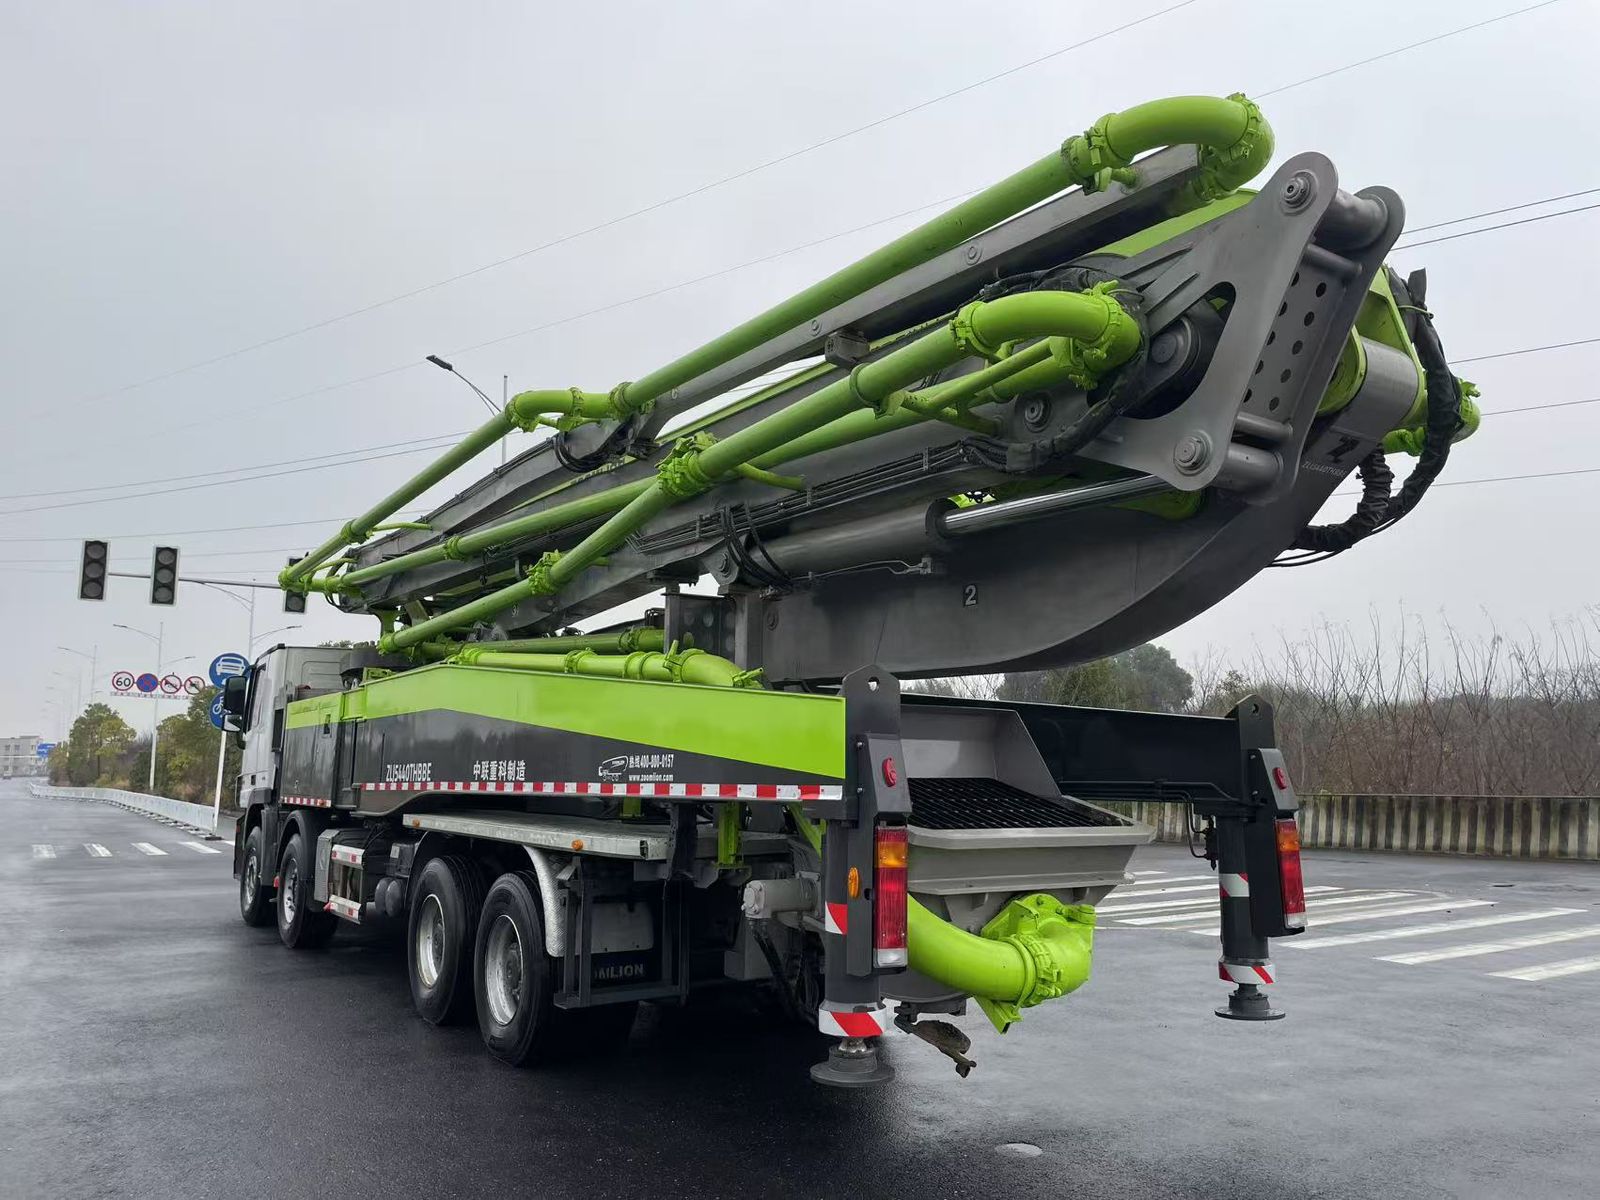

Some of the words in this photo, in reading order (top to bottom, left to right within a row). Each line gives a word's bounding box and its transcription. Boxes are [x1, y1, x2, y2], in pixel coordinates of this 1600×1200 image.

[965, 585, 977, 605] 2
[115, 677, 132, 687] 60
[385, 762, 432, 782] ZLJ5440THBBE
[473, 759, 526, 781] 中联重科制造
